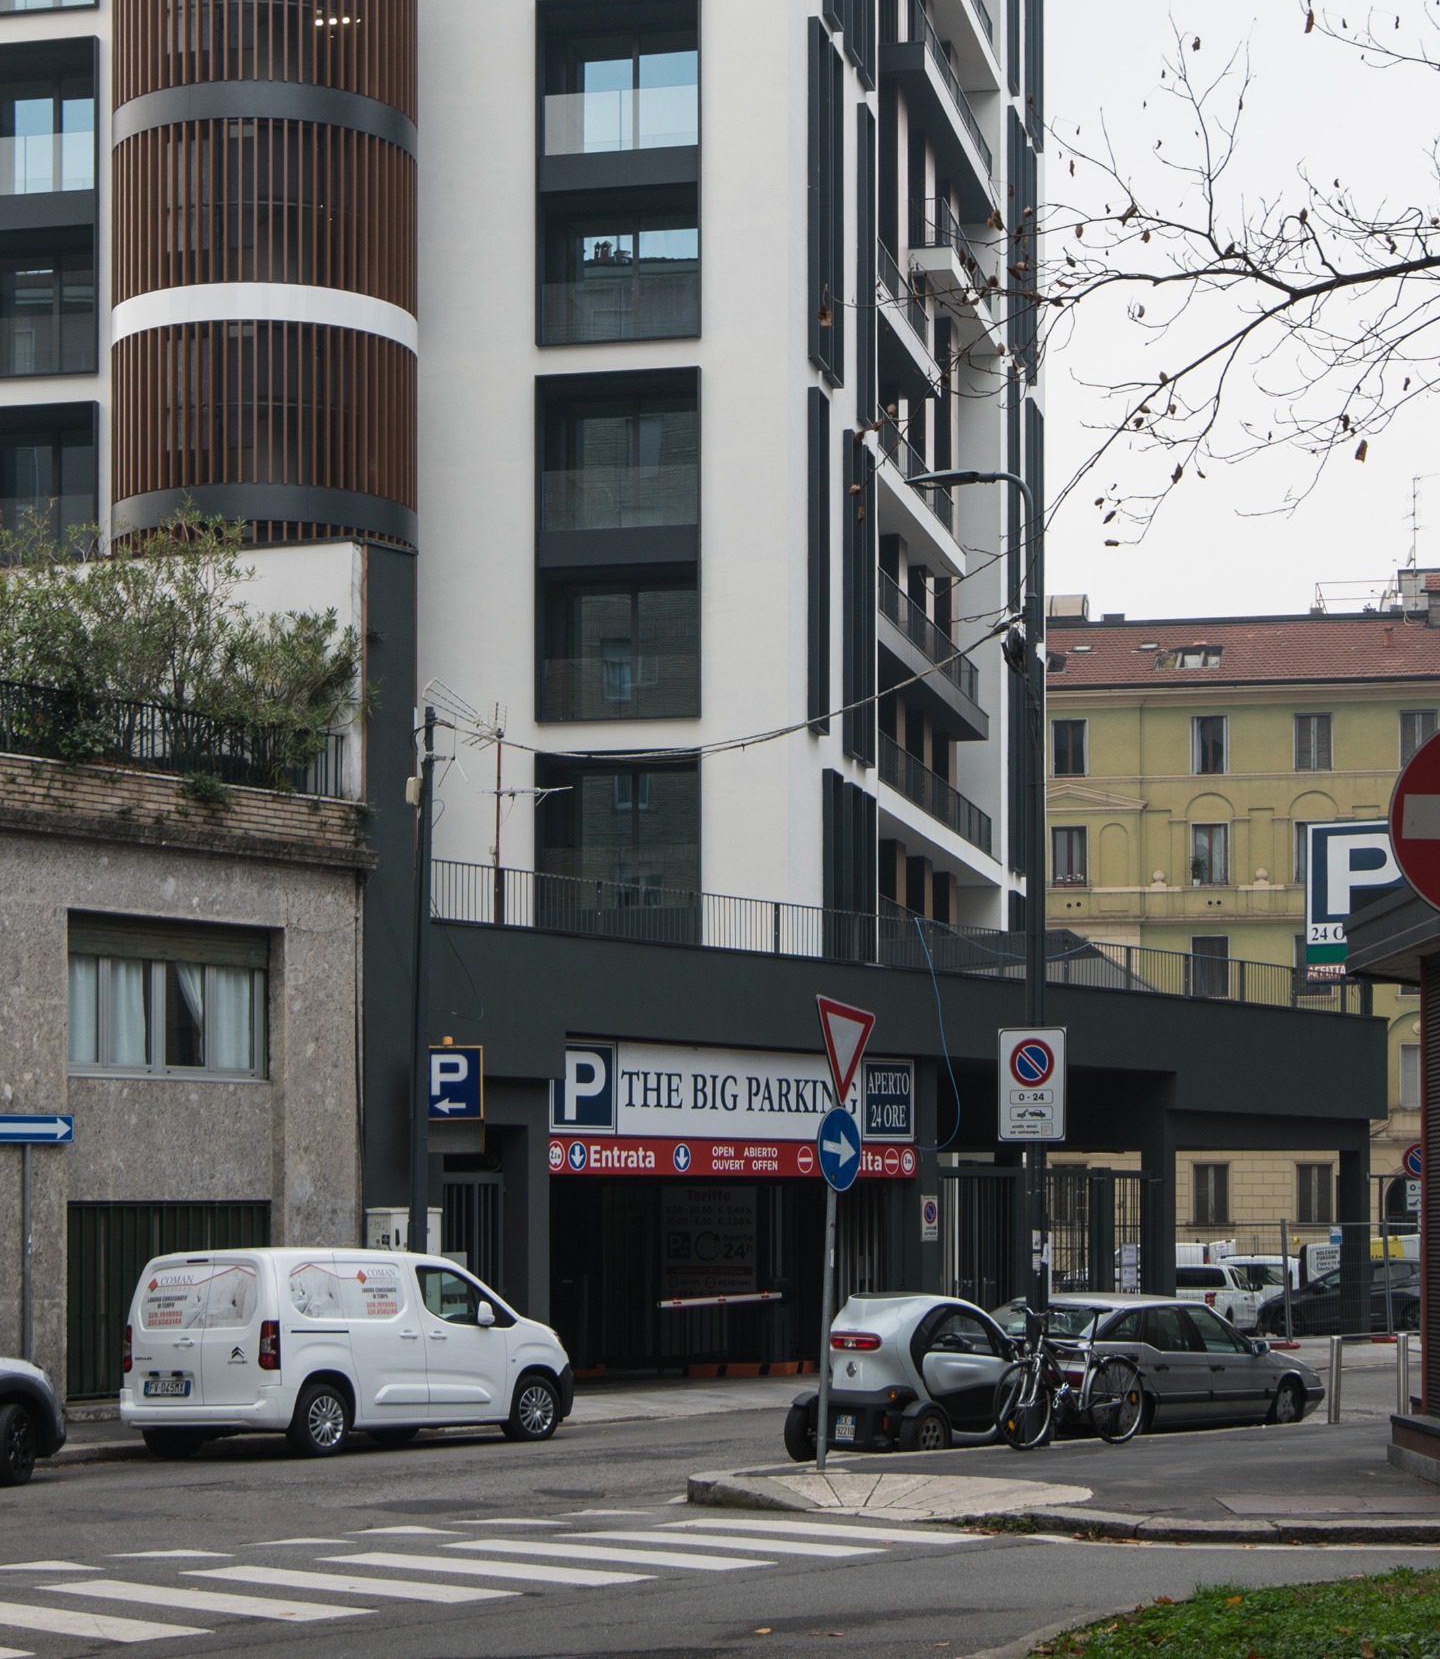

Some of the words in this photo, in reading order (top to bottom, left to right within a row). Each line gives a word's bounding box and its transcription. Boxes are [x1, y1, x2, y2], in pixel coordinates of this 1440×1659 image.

[1327, 833, 1403, 915] P
[1311, 926, 1329, 941] 24
[431, 1054, 468, 1096] P
[564, 1050, 606, 1121] P
[621, 1069, 683, 1110] THE
[691, 1074, 739, 1111] BIG
[867, 1071, 910, 1096] APERTO
[1018, 1093, 1025, 1101] 0
[1032, 1093, 1044, 1101] 24
[870, 1104, 882, 1128] 24
[883, 1105, 907, 1129] ORE
[589, 1145, 656, 1169] Entrata
[712, 1146, 735, 1157] OPEN
[743, 1146, 778, 1158] ABIERTO
[712, 1160, 745, 1171] OUVERT
[751, 1160, 779, 1171] OFFEN
[686, 1189, 732, 1202] Tariffe
[723, 1234, 753, 1243] Aperto
[366, 1268, 396, 1277] COMAN
[160, 1275, 194, 1285] COMAN
[148, 1382, 159, 1393] FV
[160, 1382, 184, 1393] 045MX
[836, 1426, 855, 1436] 92210
